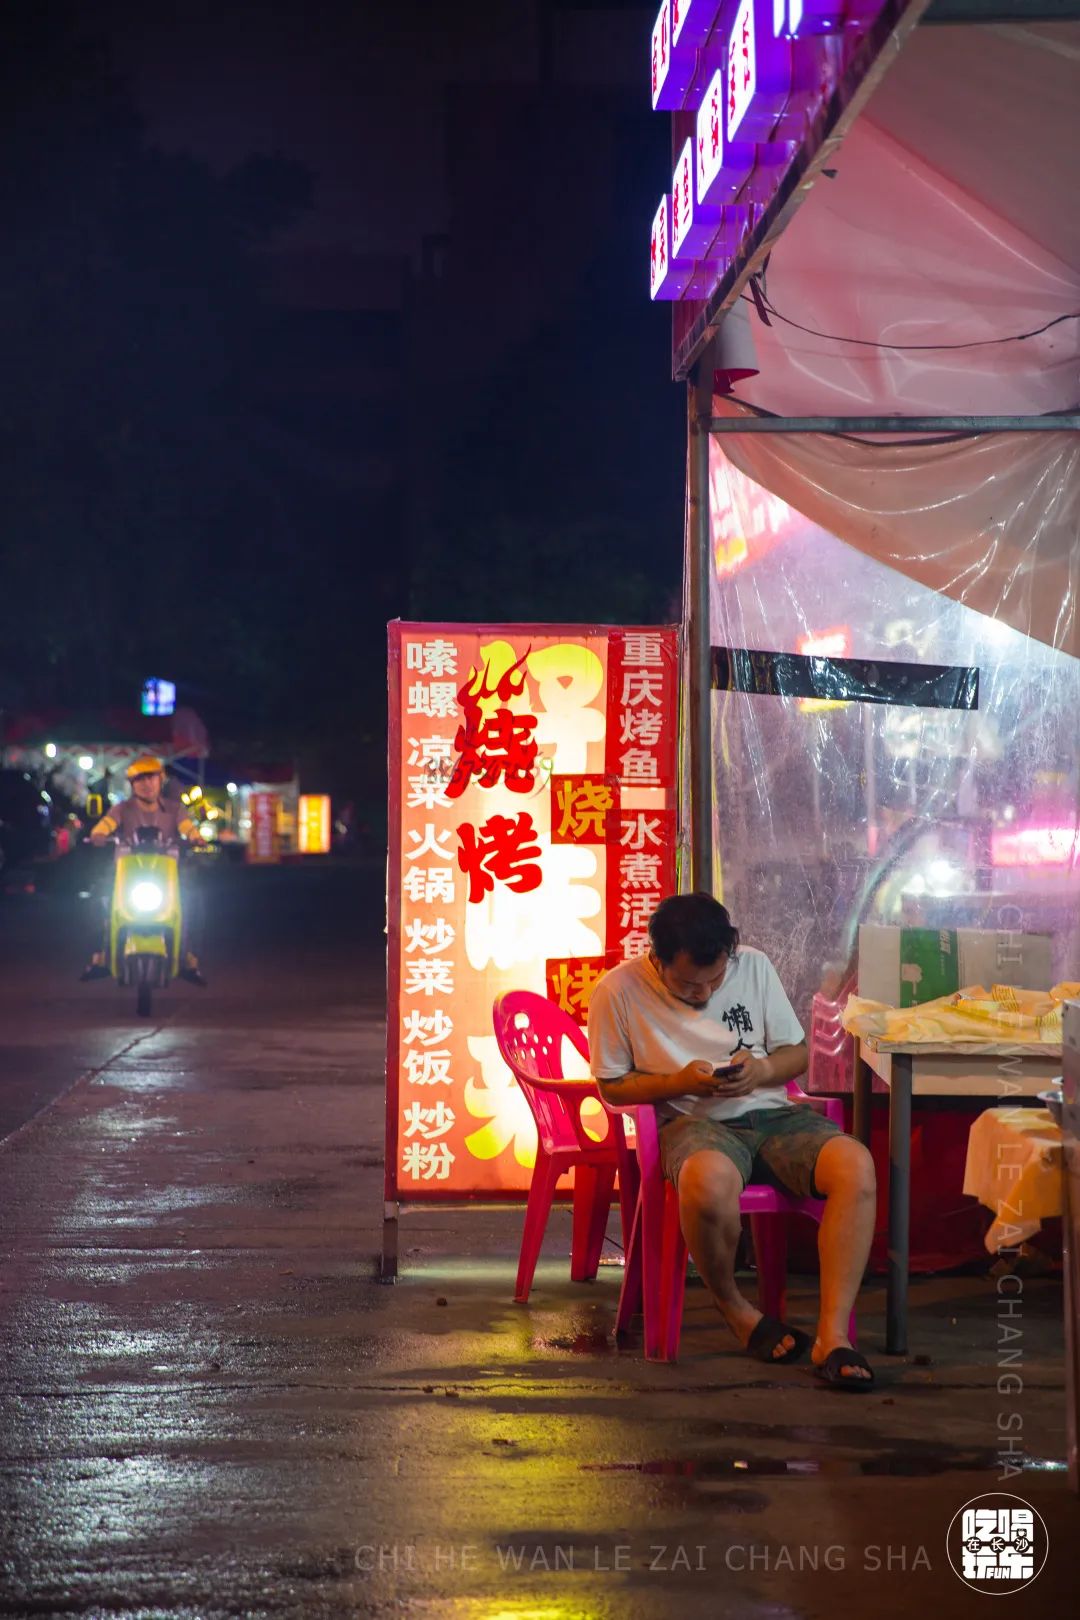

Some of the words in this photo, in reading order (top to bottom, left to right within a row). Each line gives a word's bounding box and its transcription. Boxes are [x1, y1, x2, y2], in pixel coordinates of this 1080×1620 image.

[405, 639, 458, 718] 嗦螺
[618, 632, 665, 786] 重庆烤鱼
[406, 734, 455, 810] 凉菜
[444, 642, 543, 904] 烧烤
[403, 823, 456, 904] 火锅
[404, 917, 456, 996] 炒菜
[402, 1009, 455, 1086] 炒饭
[402, 1101, 456, 1181] 炒粉
